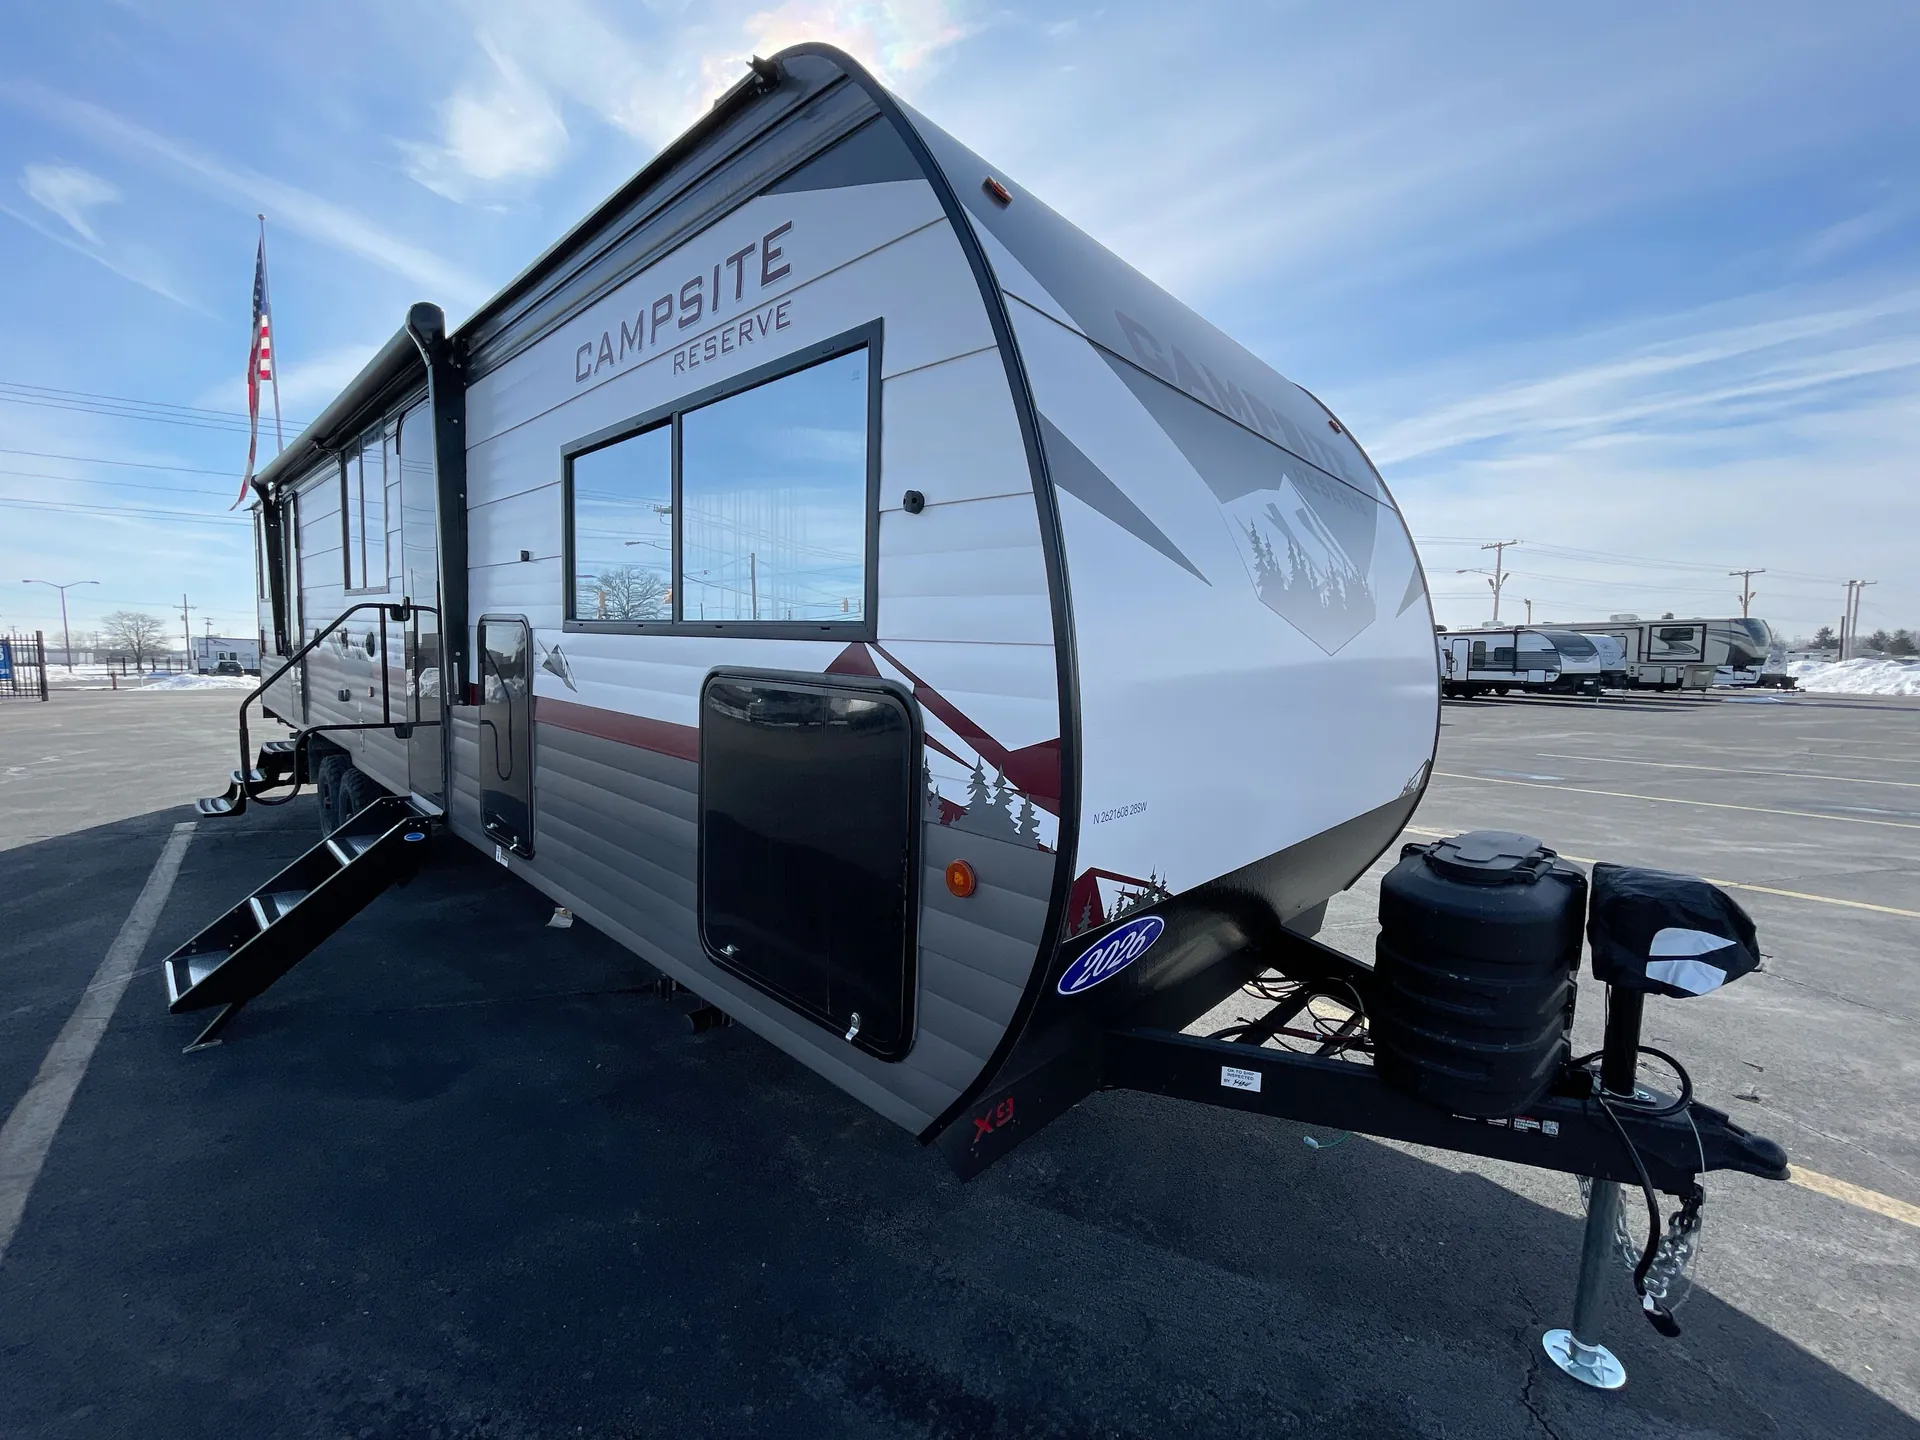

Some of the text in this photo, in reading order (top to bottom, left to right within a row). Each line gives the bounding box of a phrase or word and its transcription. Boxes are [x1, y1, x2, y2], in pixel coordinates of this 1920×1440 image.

[575, 220, 793, 382] CAMPSITE
[673, 300, 792, 376] RESERVE
[1070, 921, 1155, 990] 2026
